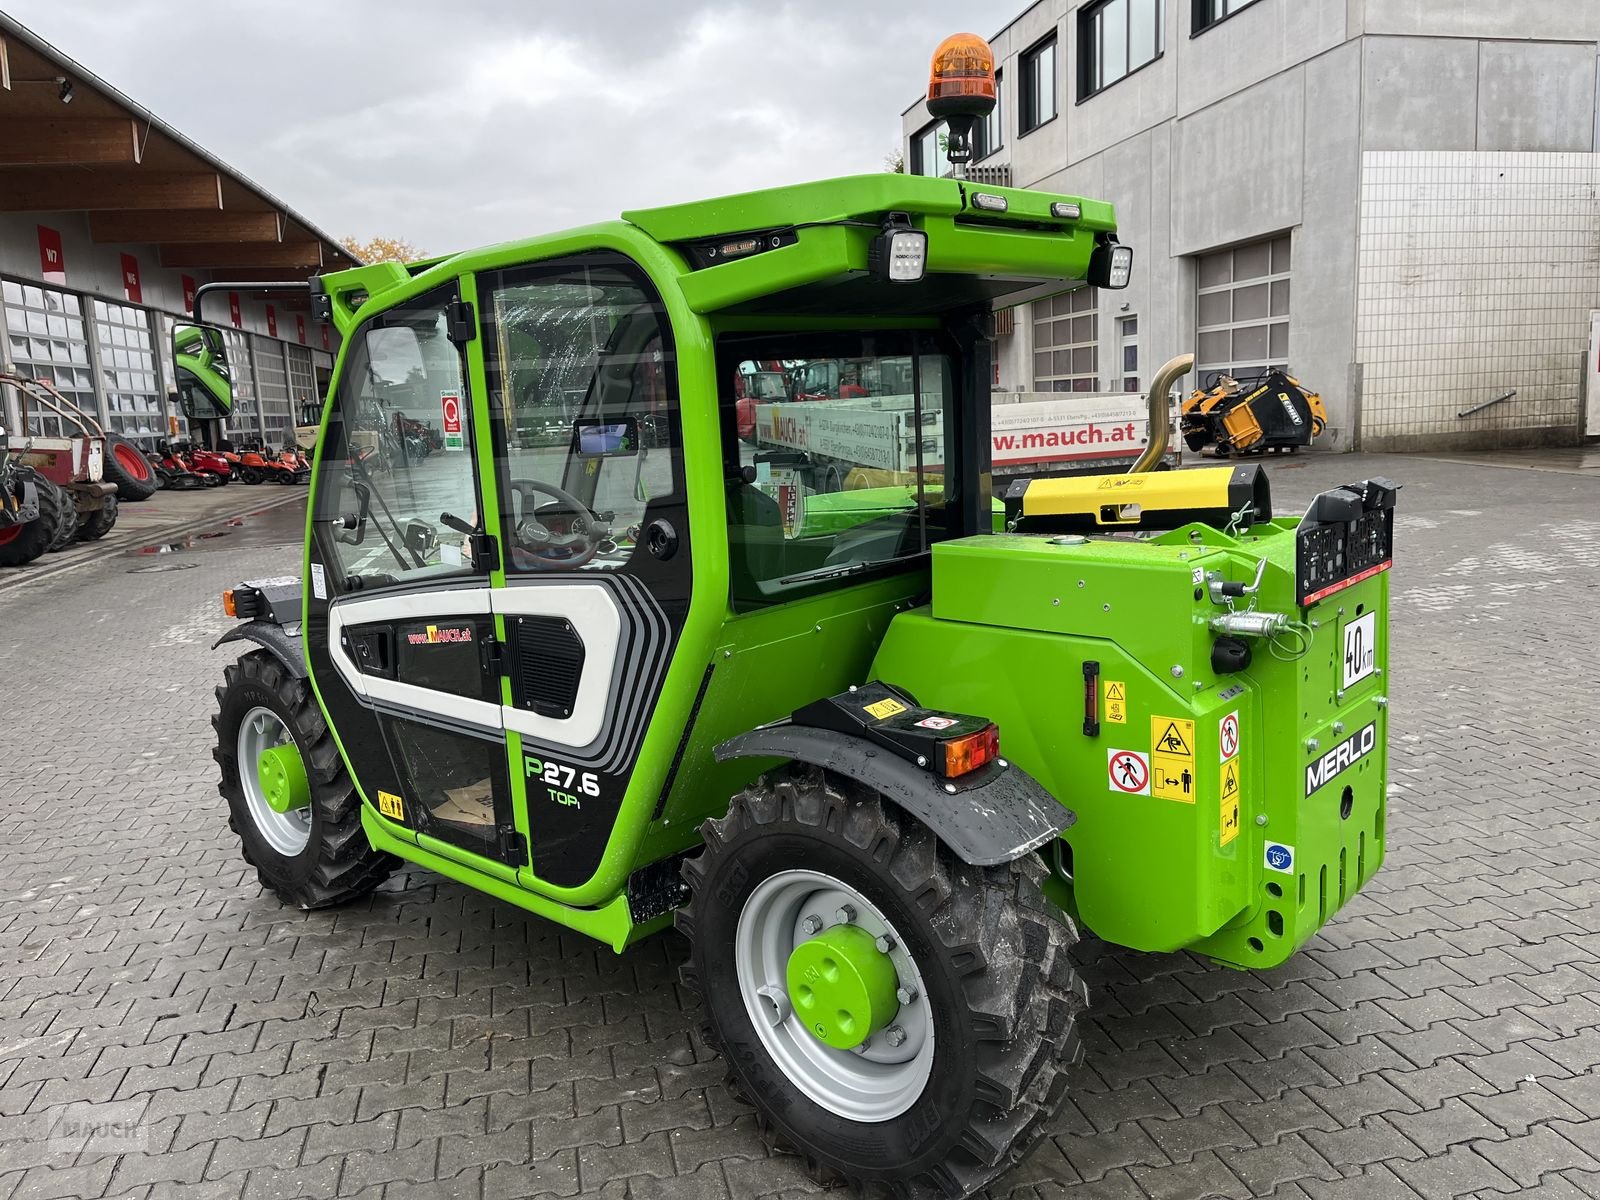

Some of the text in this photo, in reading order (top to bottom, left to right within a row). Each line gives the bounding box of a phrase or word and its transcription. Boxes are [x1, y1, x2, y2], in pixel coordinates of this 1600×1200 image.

[46, 247, 57, 264] W7
[408, 627, 472, 645] www.MAUCH.at
[1345, 625, 1373, 678] 40 km
[1306, 723, 1375, 795] MERLO
